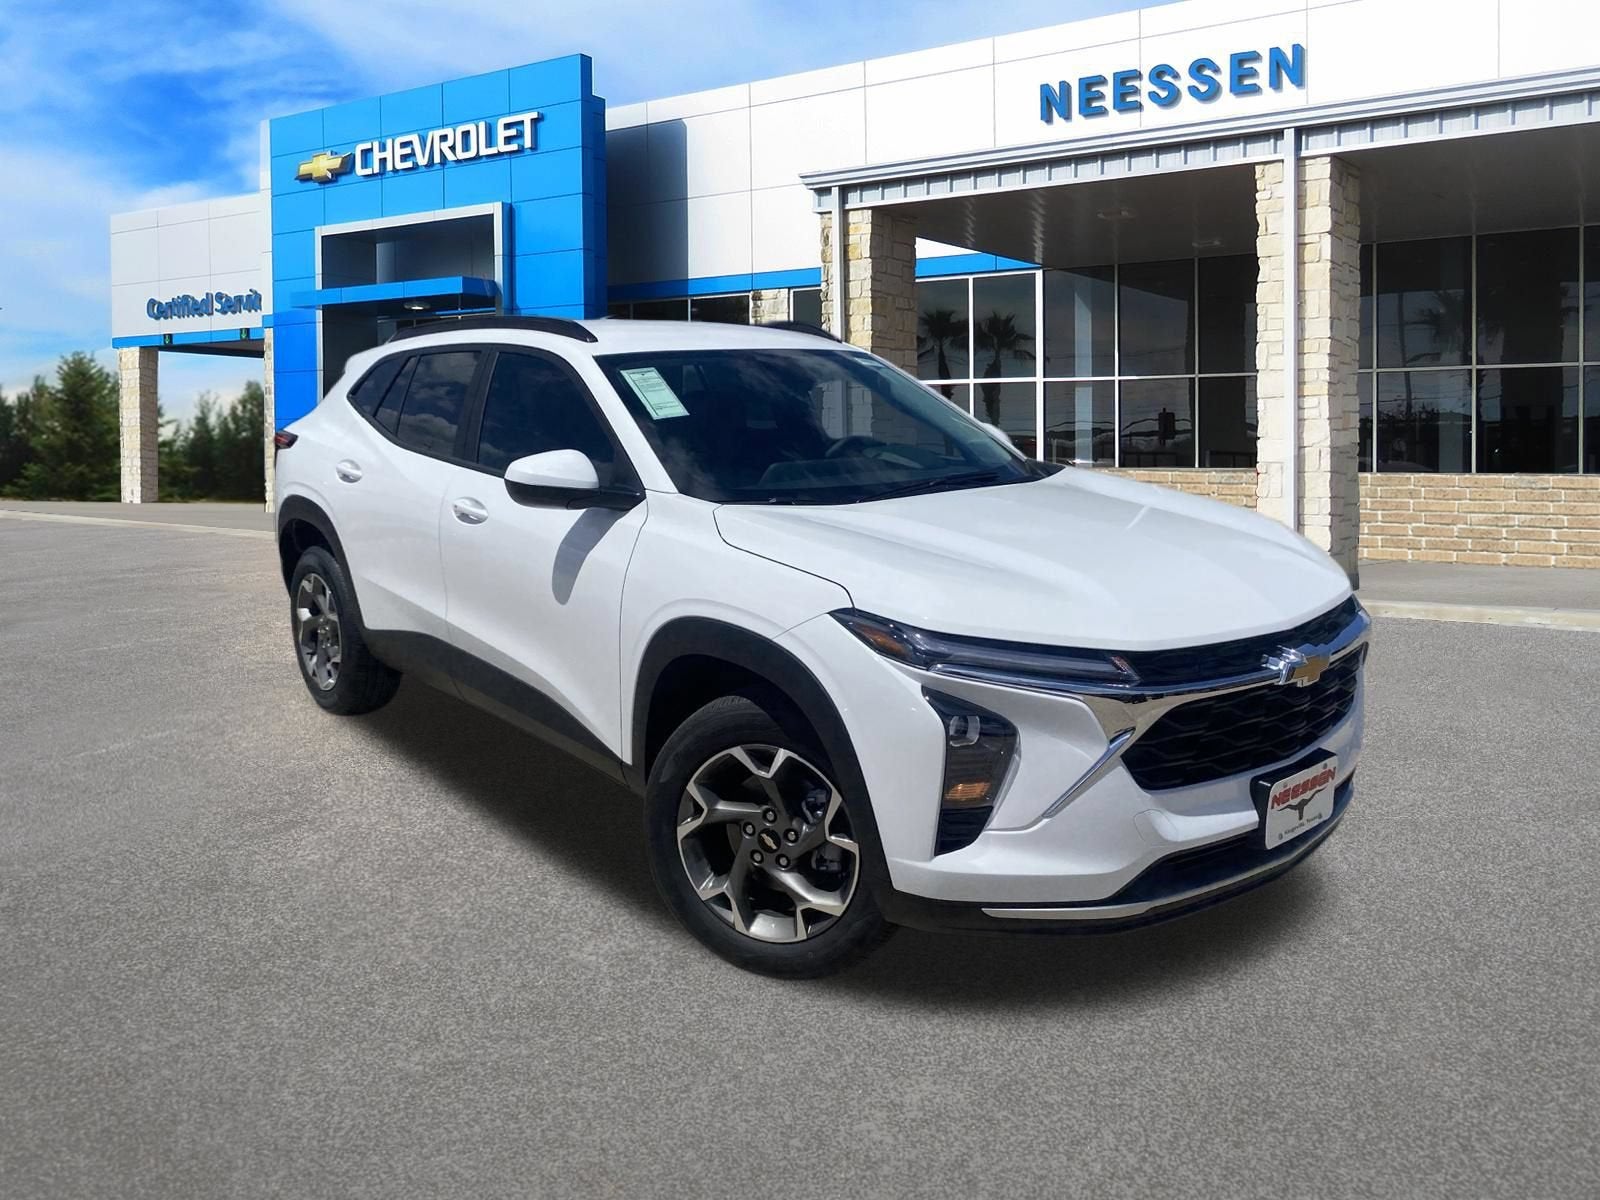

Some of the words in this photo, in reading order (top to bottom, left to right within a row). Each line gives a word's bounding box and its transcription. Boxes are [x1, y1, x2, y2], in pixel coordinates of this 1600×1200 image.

[1040, 43, 1307, 124] NEESSEN
[355, 110, 543, 178] CHEVROLET
[146, 292, 214, 320] Certified
[214, 288, 263, 315] Servi
[1270, 766, 1337, 810] NEESSEN
